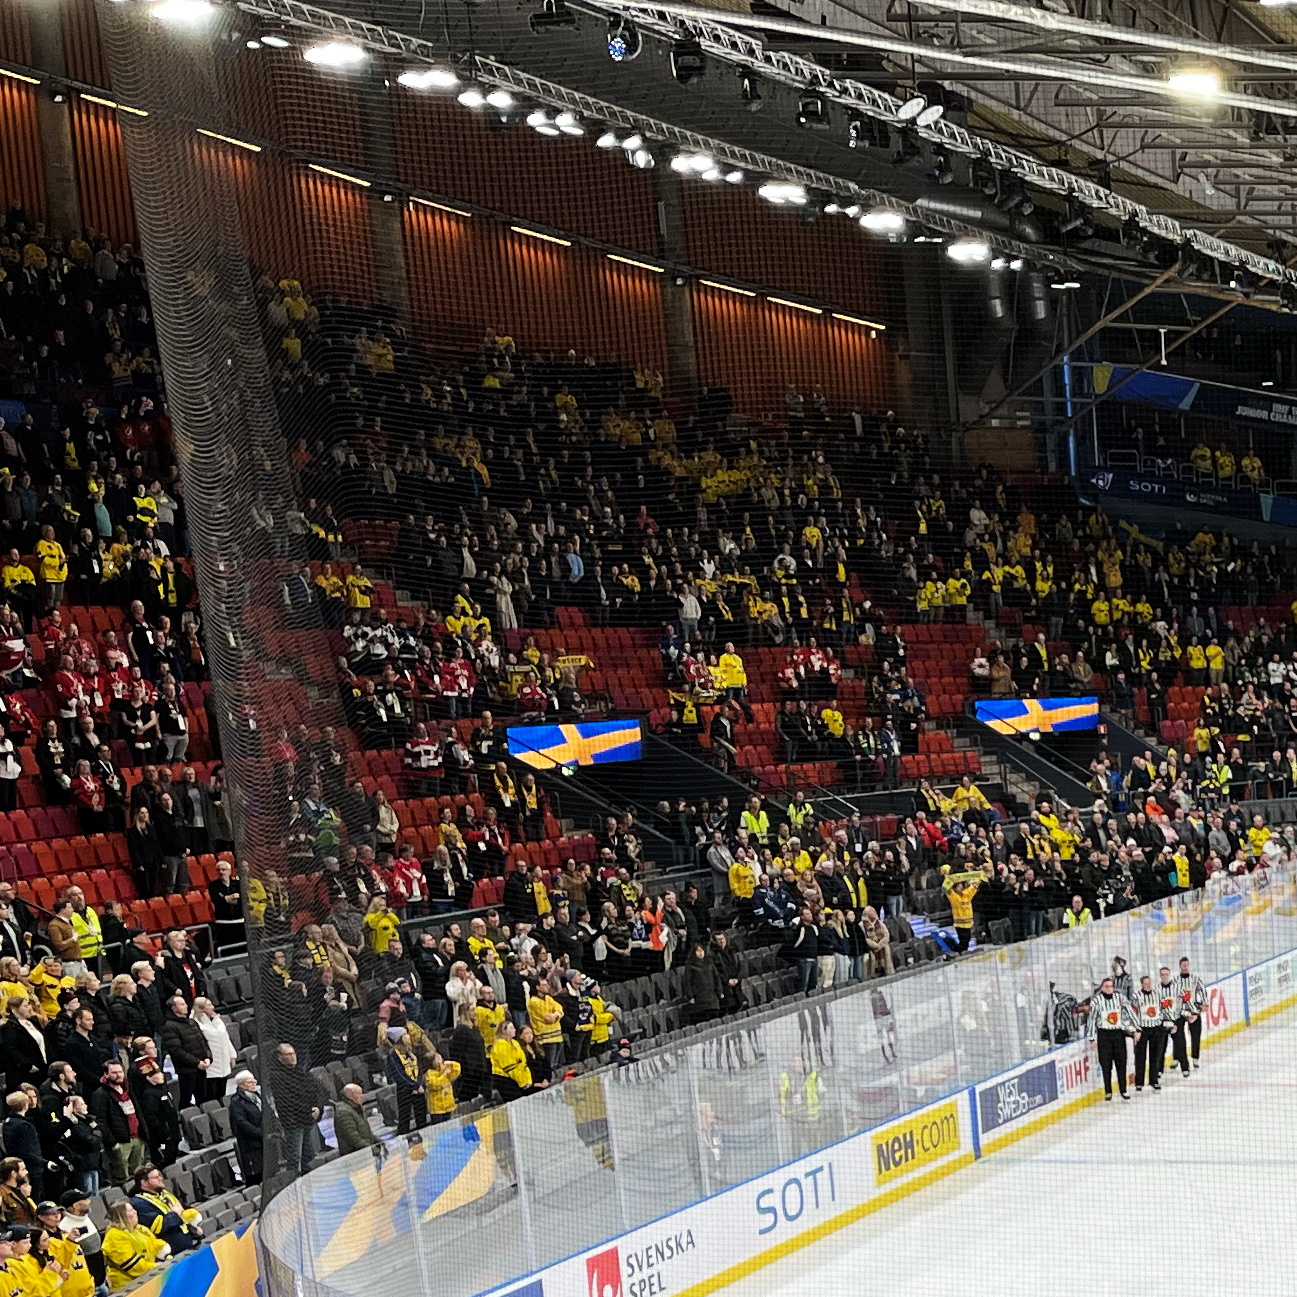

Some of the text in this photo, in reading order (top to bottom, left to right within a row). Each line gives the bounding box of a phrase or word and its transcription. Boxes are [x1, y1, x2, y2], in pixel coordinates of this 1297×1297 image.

[1129, 481, 1167, 495] SOTI
[1065, 1055, 1090, 1091] IIHF
[756, 1161, 836, 1235] SOTI
[626, 1229, 696, 1278] SVENSKA
